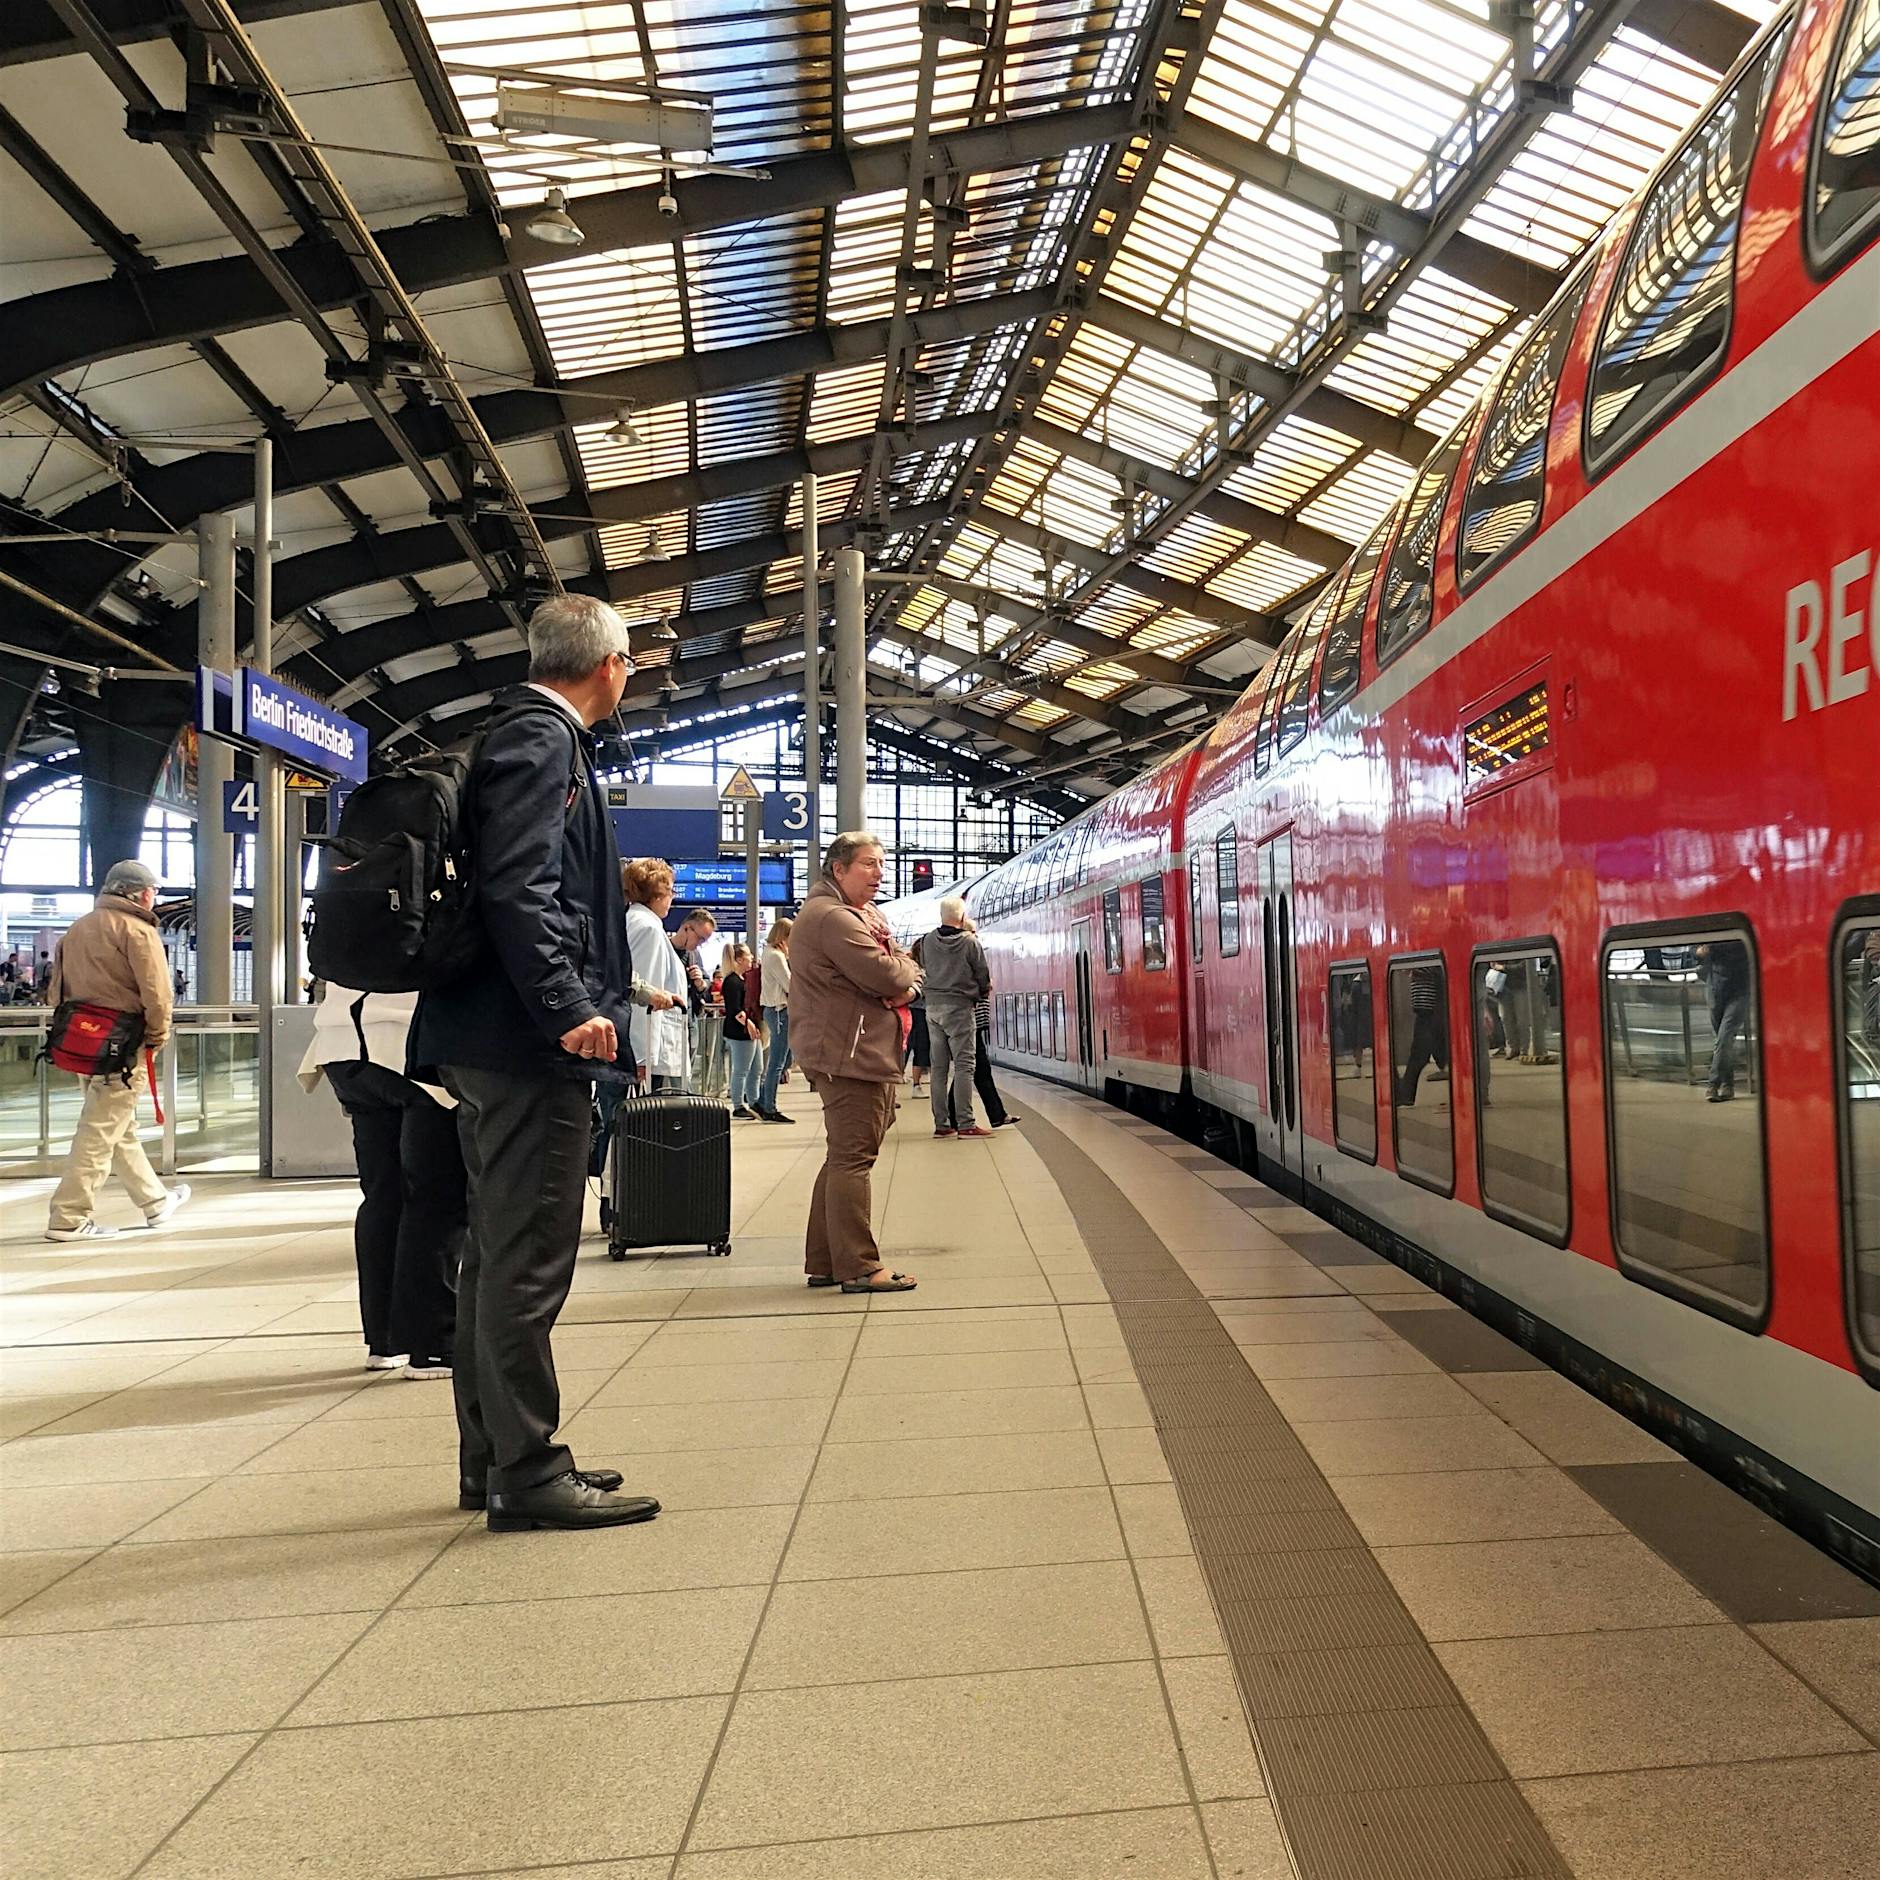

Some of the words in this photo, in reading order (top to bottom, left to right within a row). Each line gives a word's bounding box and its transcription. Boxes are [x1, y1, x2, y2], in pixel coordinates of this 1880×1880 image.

[252, 683, 285, 730] Berlin
[286, 700, 354, 761] Friedrichstraße
[231, 782, 260, 821] 4
[610, 793, 625, 801] TAXI
[783, 792, 809, 830] 3
[695, 872, 732, 881] Magdeburg
